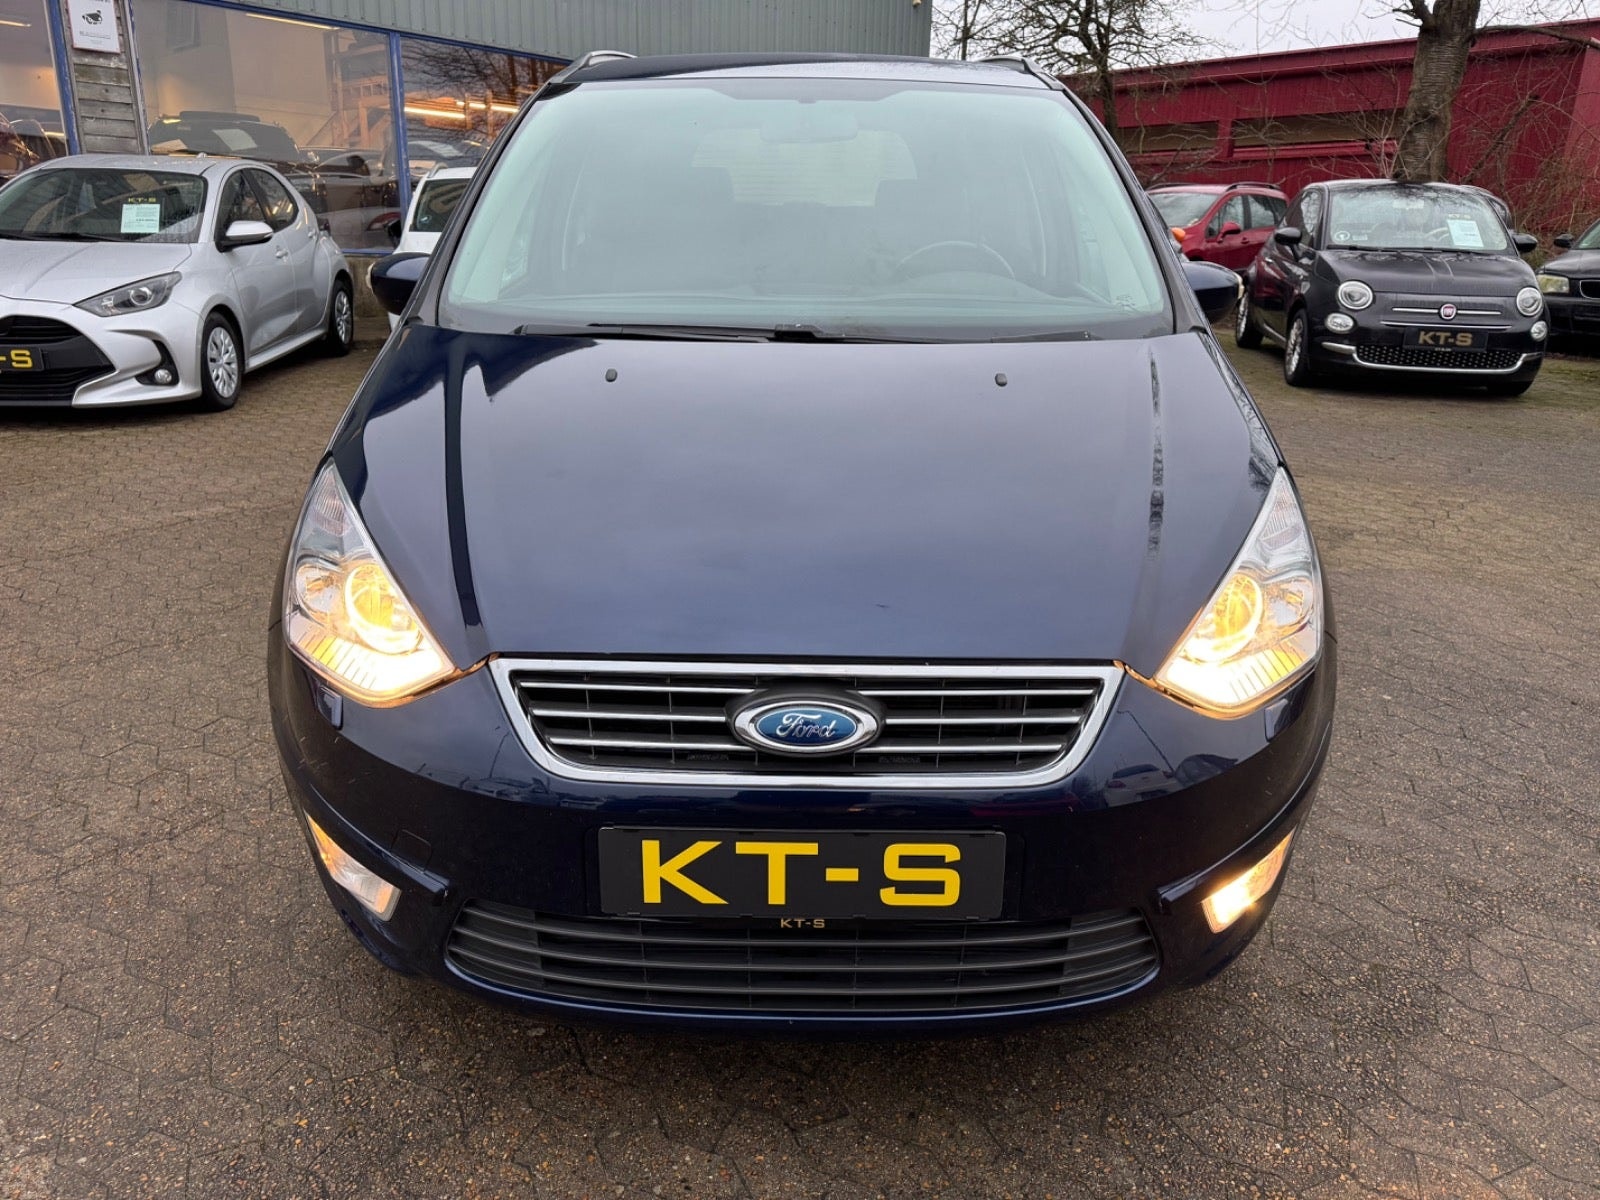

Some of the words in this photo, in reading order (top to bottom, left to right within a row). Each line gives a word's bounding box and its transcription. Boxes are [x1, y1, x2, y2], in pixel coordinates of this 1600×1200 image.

[1418, 331, 1472, 346] KT-S
[776, 713, 837, 738] Ford
[642, 839, 961, 907] KT-S
[780, 918, 826, 929] KT-S
